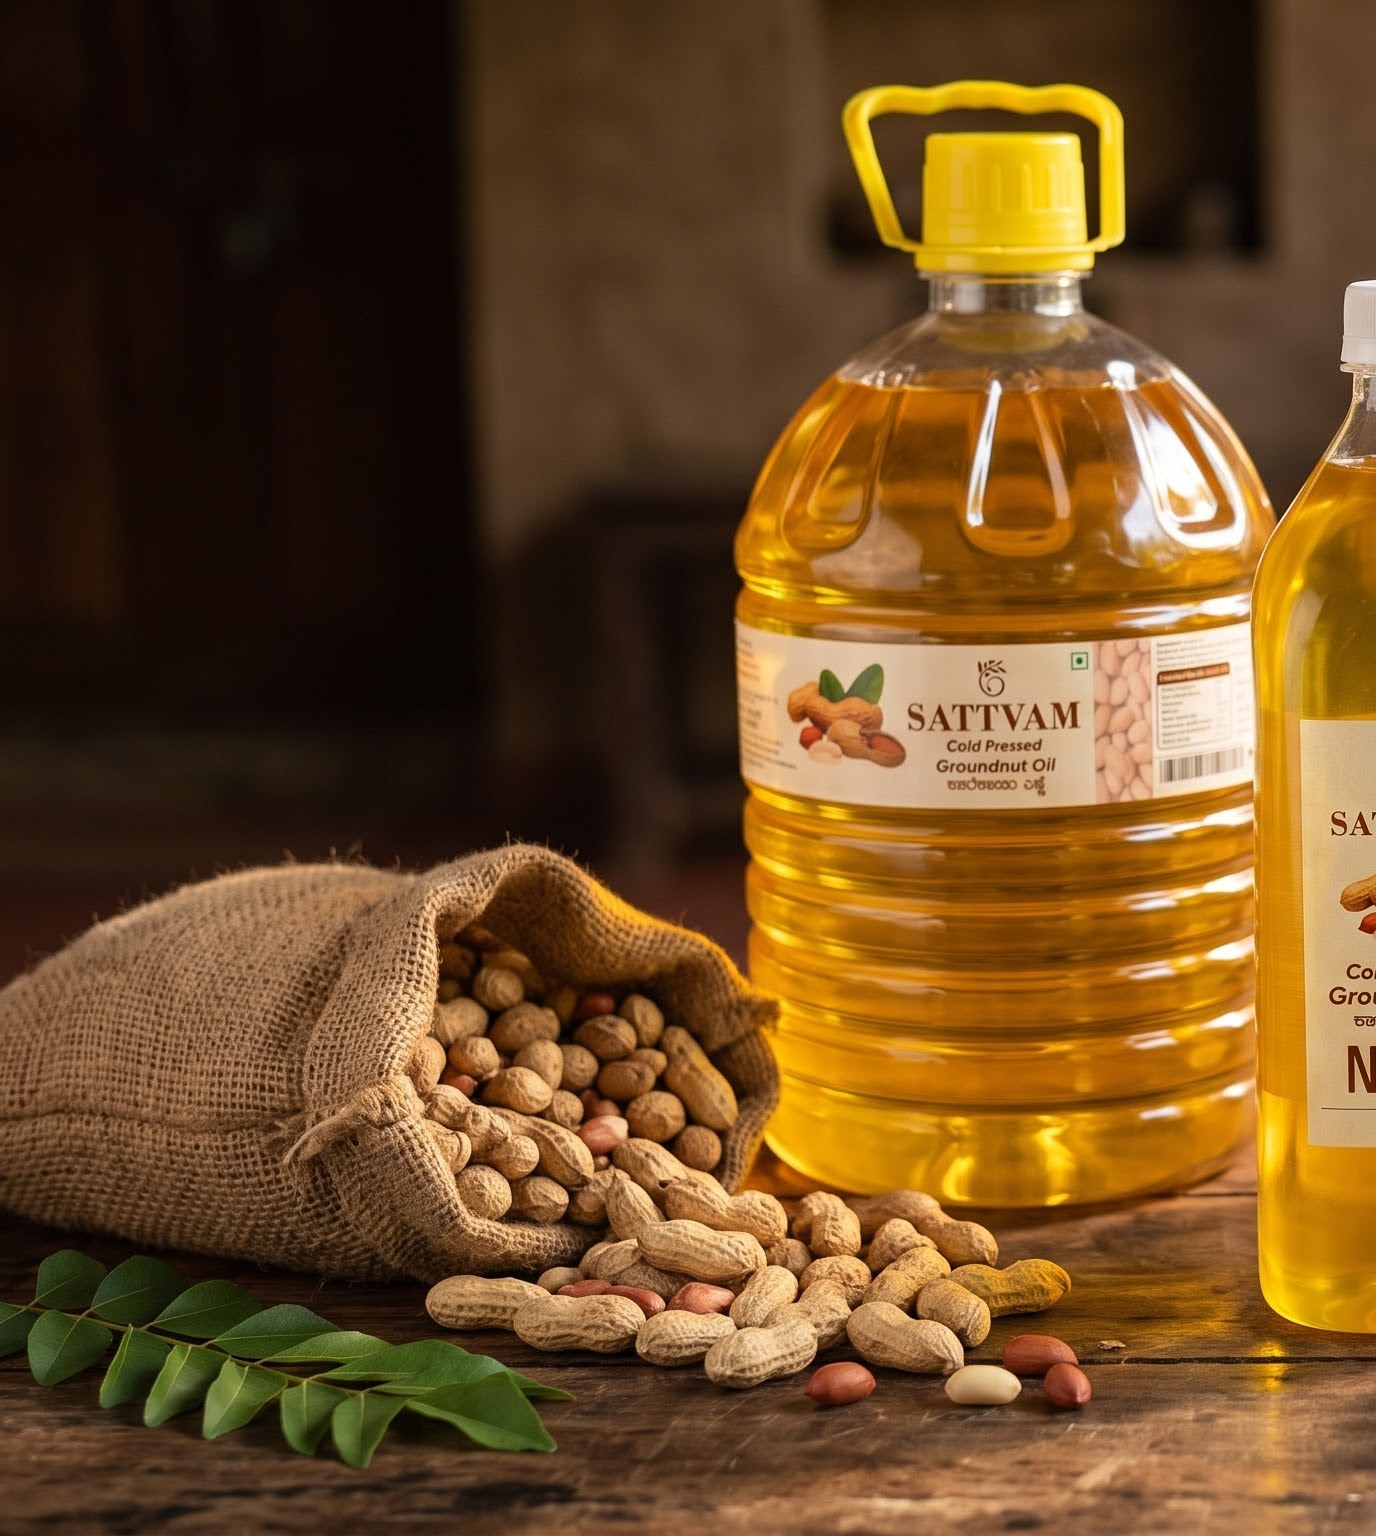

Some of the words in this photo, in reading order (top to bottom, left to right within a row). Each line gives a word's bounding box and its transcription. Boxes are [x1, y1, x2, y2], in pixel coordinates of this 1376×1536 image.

[907, 700, 1081, 732] SATTVAM
[946, 739, 982, 753] Cold
[984, 738, 1043, 753] Pressed
[936, 758, 1028, 775] Groundnut
[1031, 757, 1057, 773] Oil
